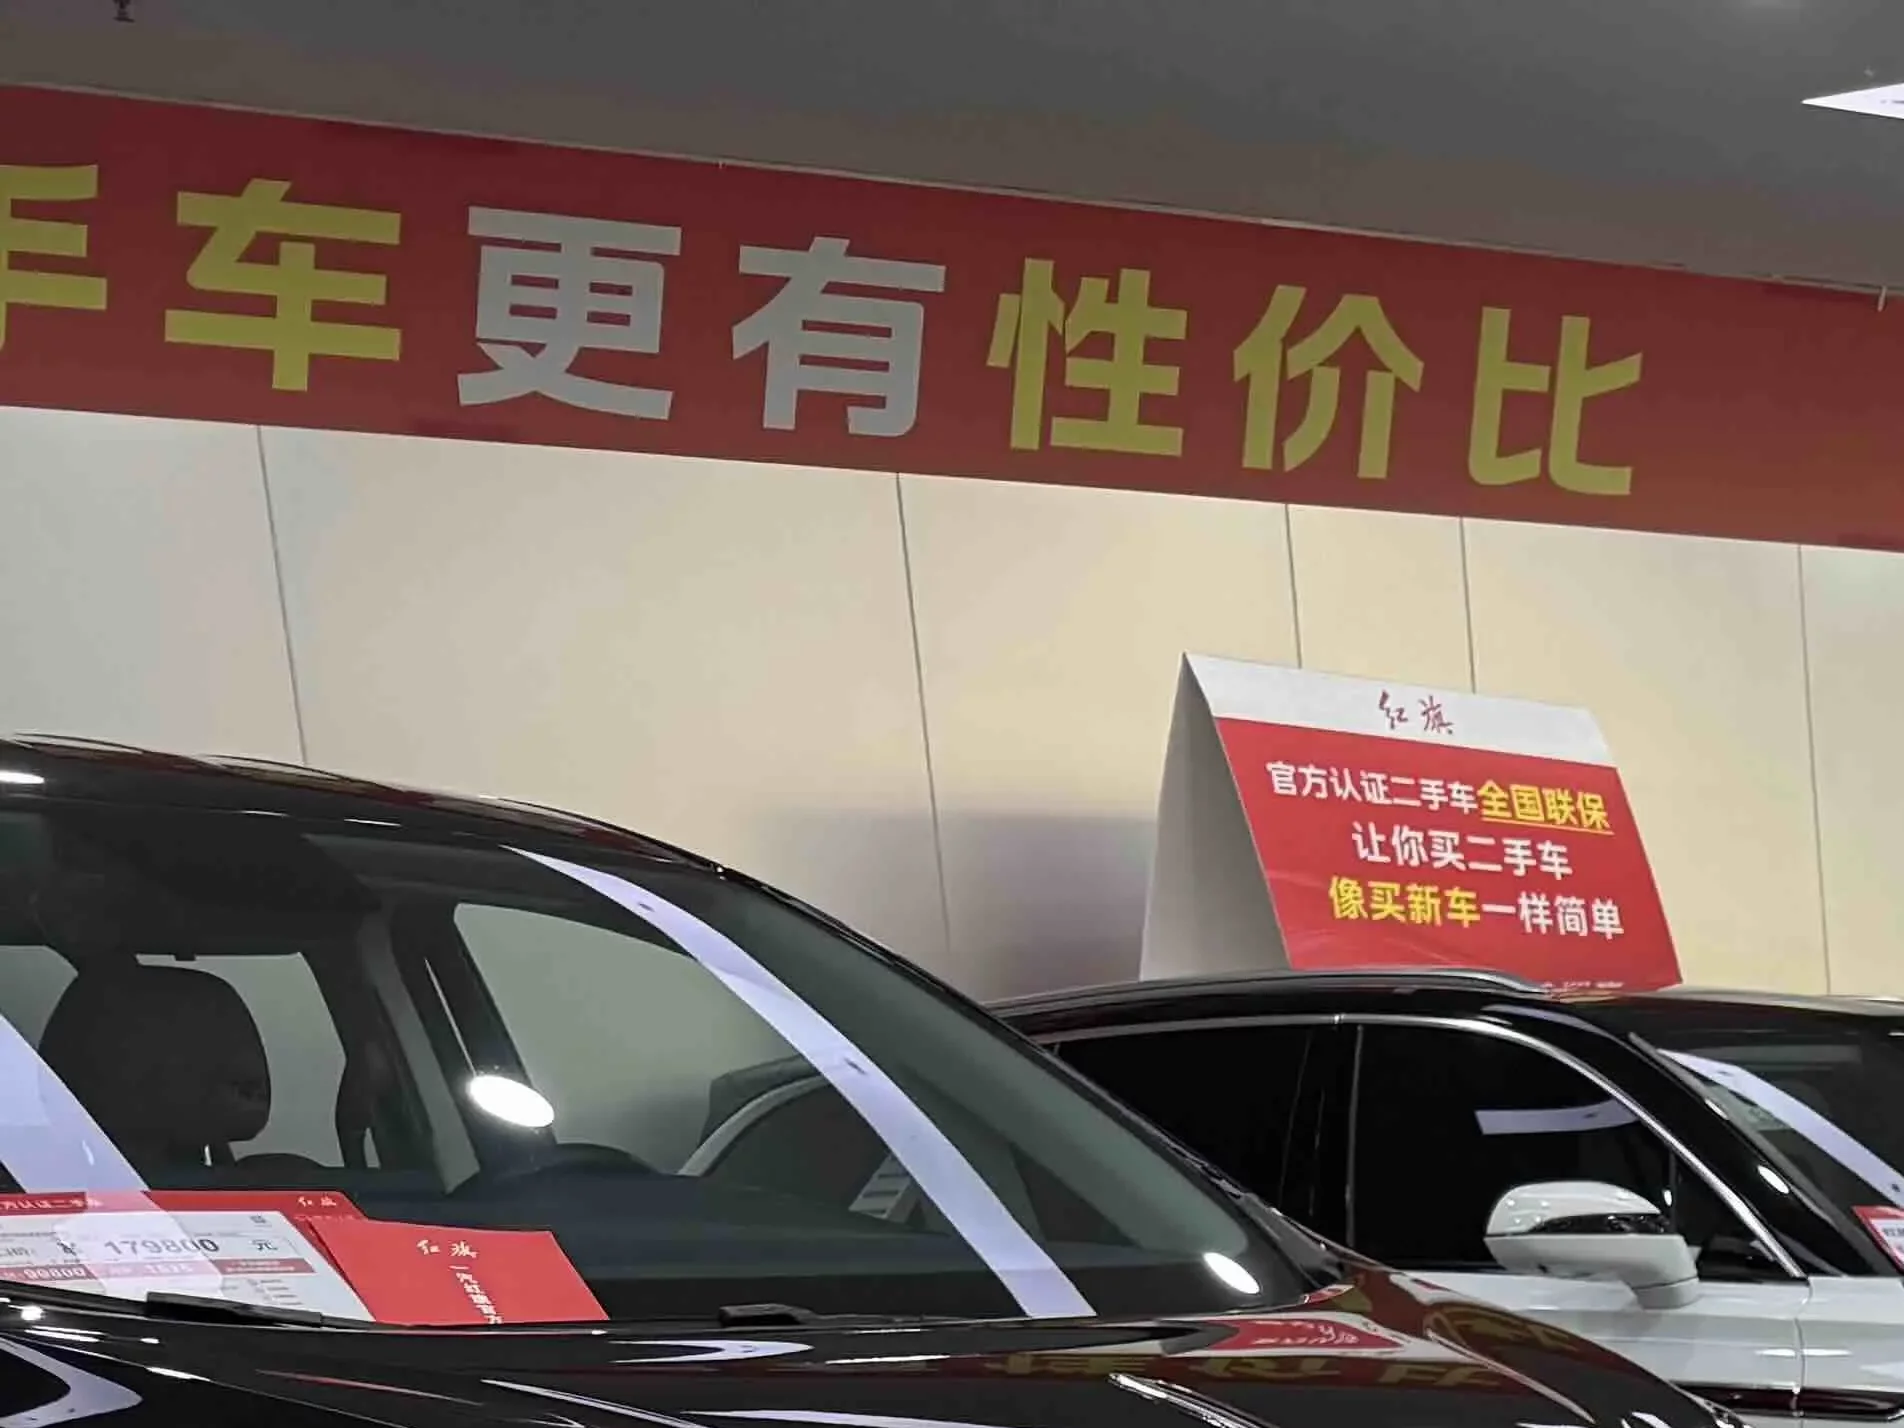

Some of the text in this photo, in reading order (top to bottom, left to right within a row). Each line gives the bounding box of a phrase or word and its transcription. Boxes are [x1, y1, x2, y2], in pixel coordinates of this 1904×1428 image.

[1378, 689, 1453, 735] 红旗
[1265, 760, 1611, 830] 官方认证二手车全国联保
[1351, 822, 1573, 880] 让你买二手车
[1328, 876, 1625, 940] 像买新车一样简单
